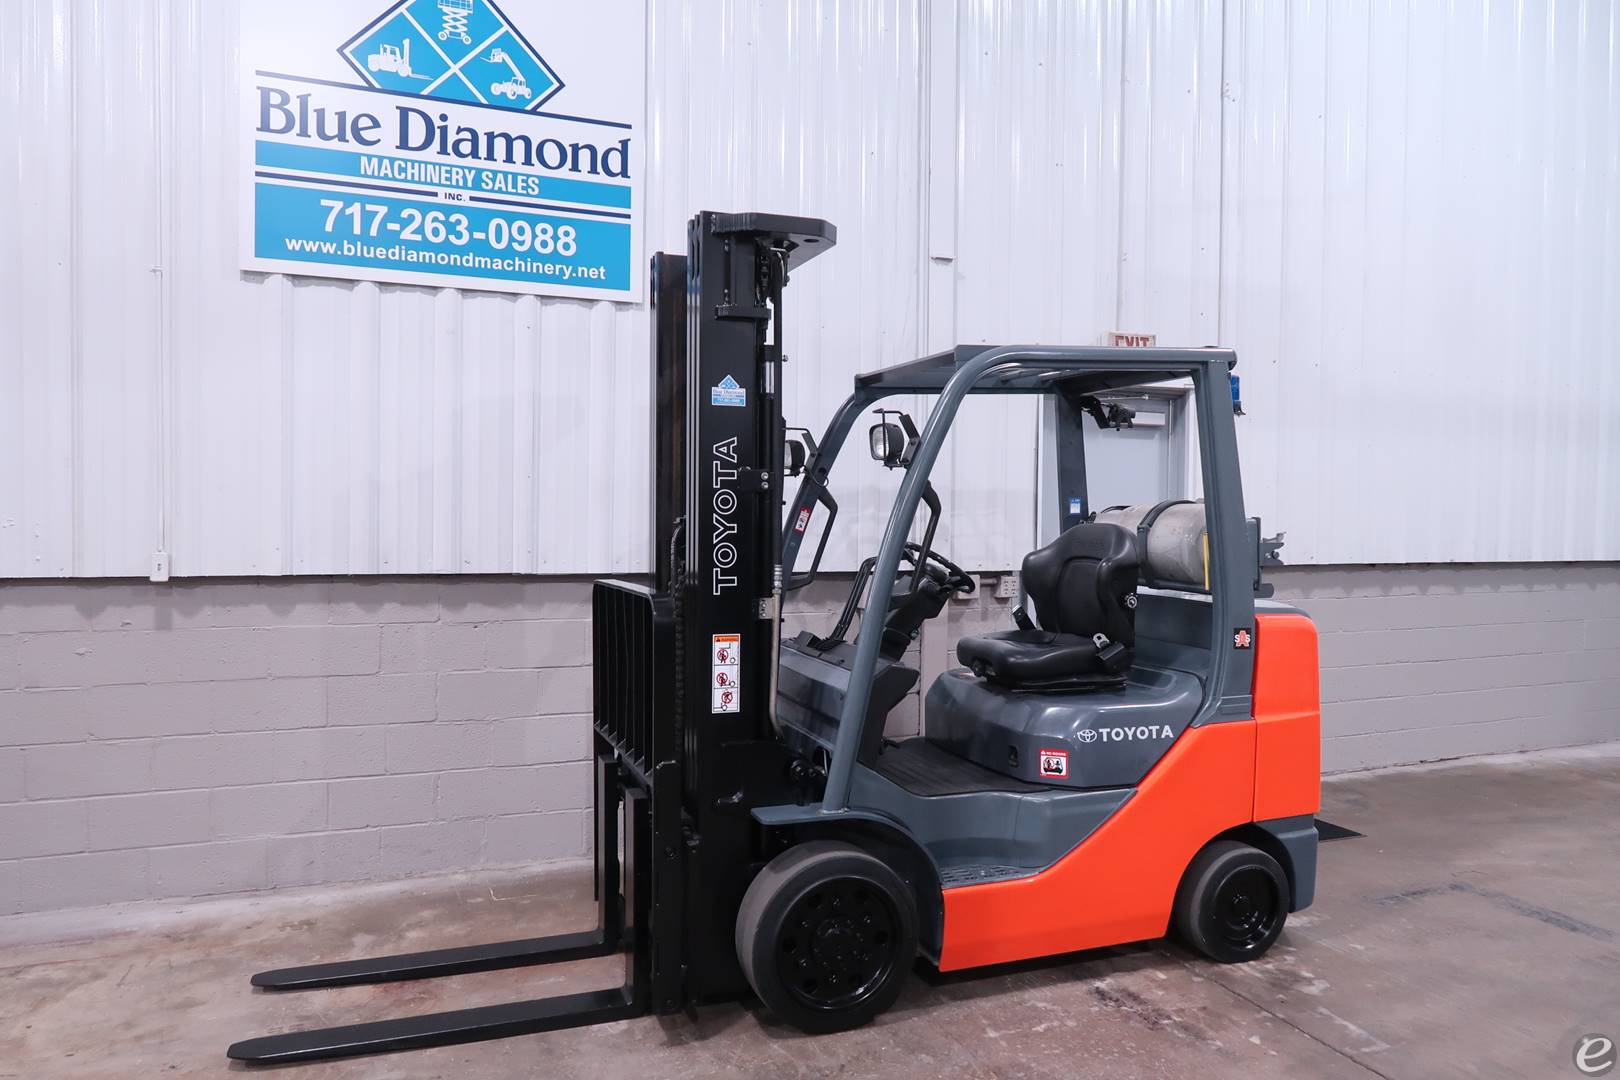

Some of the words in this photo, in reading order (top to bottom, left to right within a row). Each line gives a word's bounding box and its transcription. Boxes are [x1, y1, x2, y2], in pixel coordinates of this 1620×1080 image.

[256, 86, 381, 146] Blue
[395, 106, 631, 178] Diamond
[360, 156, 475, 188] MACHINERY
[481, 171, 540, 195] SALES
[444, 192, 466, 202] INC.
[320, 199, 577, 257] 717-263-0988
[285, 236, 606, 280] www.bluediamondmachinery.net
[713, 436, 738, 596] TOYOTA
[1099, 725, 1174, 742] TOYOTA
